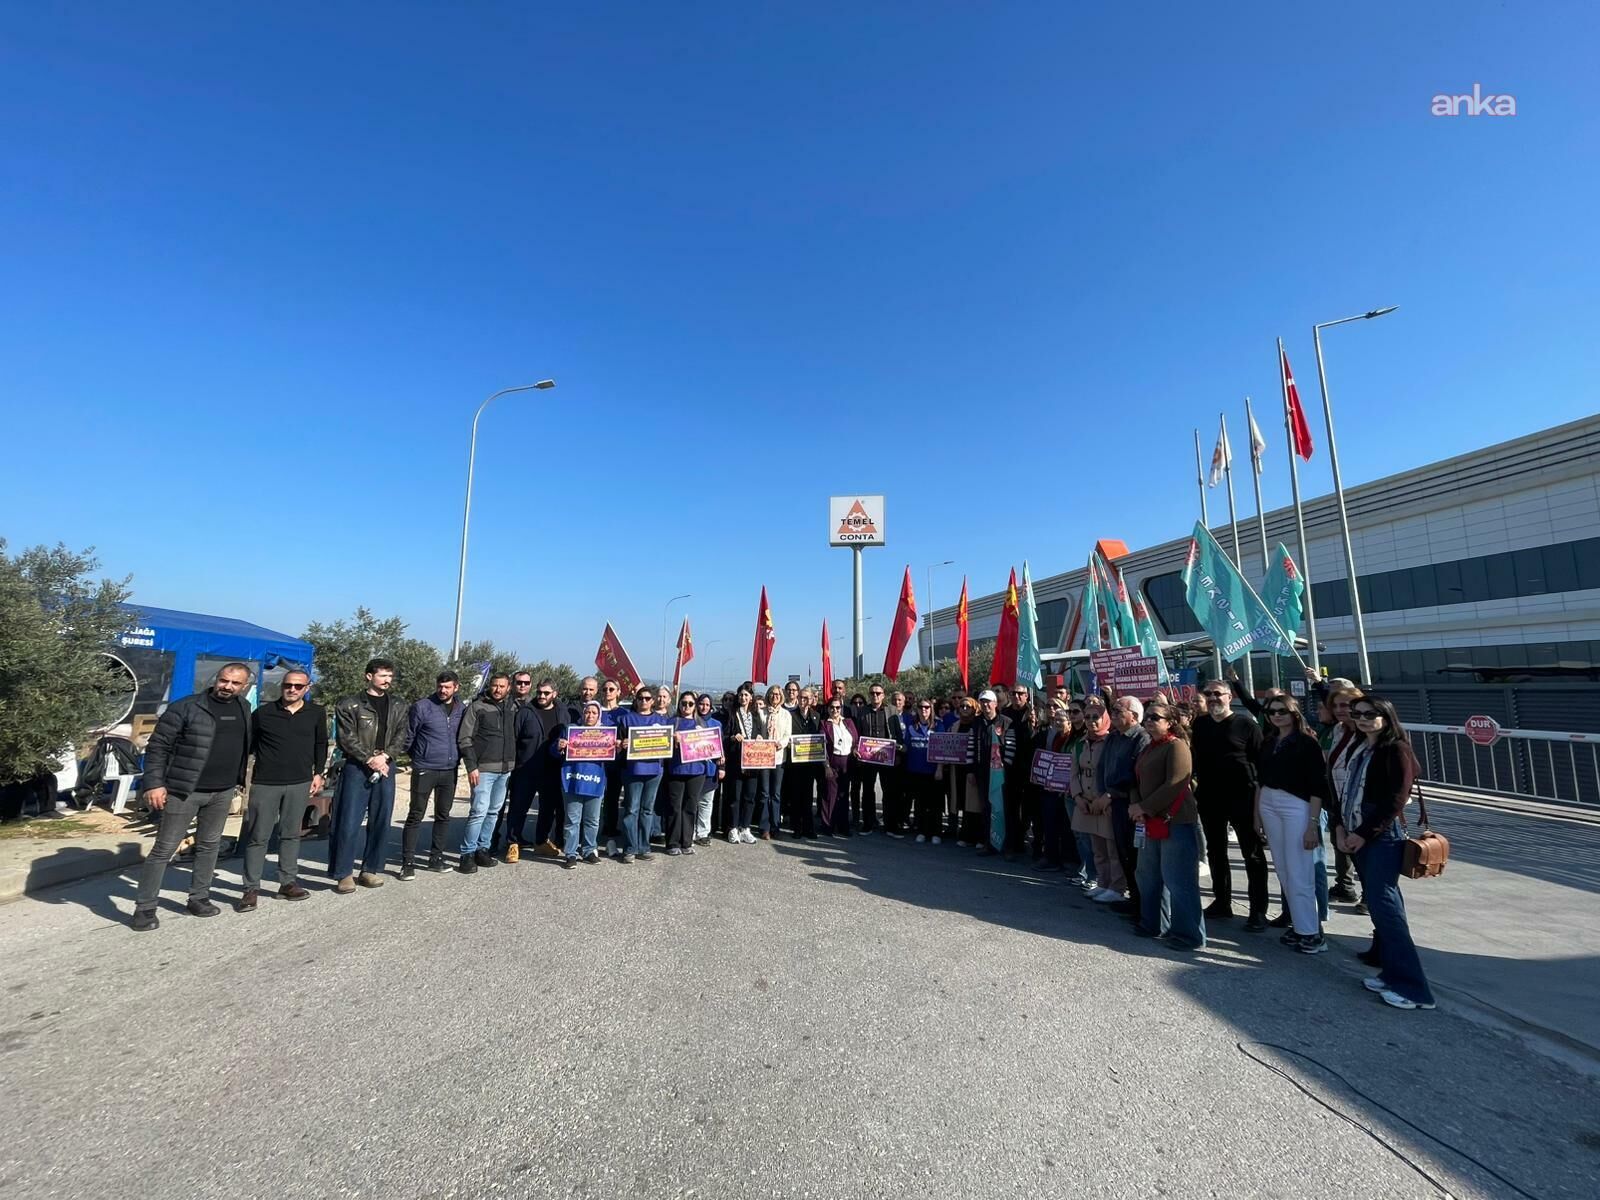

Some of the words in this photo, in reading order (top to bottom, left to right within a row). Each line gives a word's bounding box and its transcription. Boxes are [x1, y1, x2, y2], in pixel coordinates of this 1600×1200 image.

[121, 636, 154, 647] ŞUBESİ
[1169, 673, 1180, 682] DE
[1471, 720, 1490, 728] DUR
